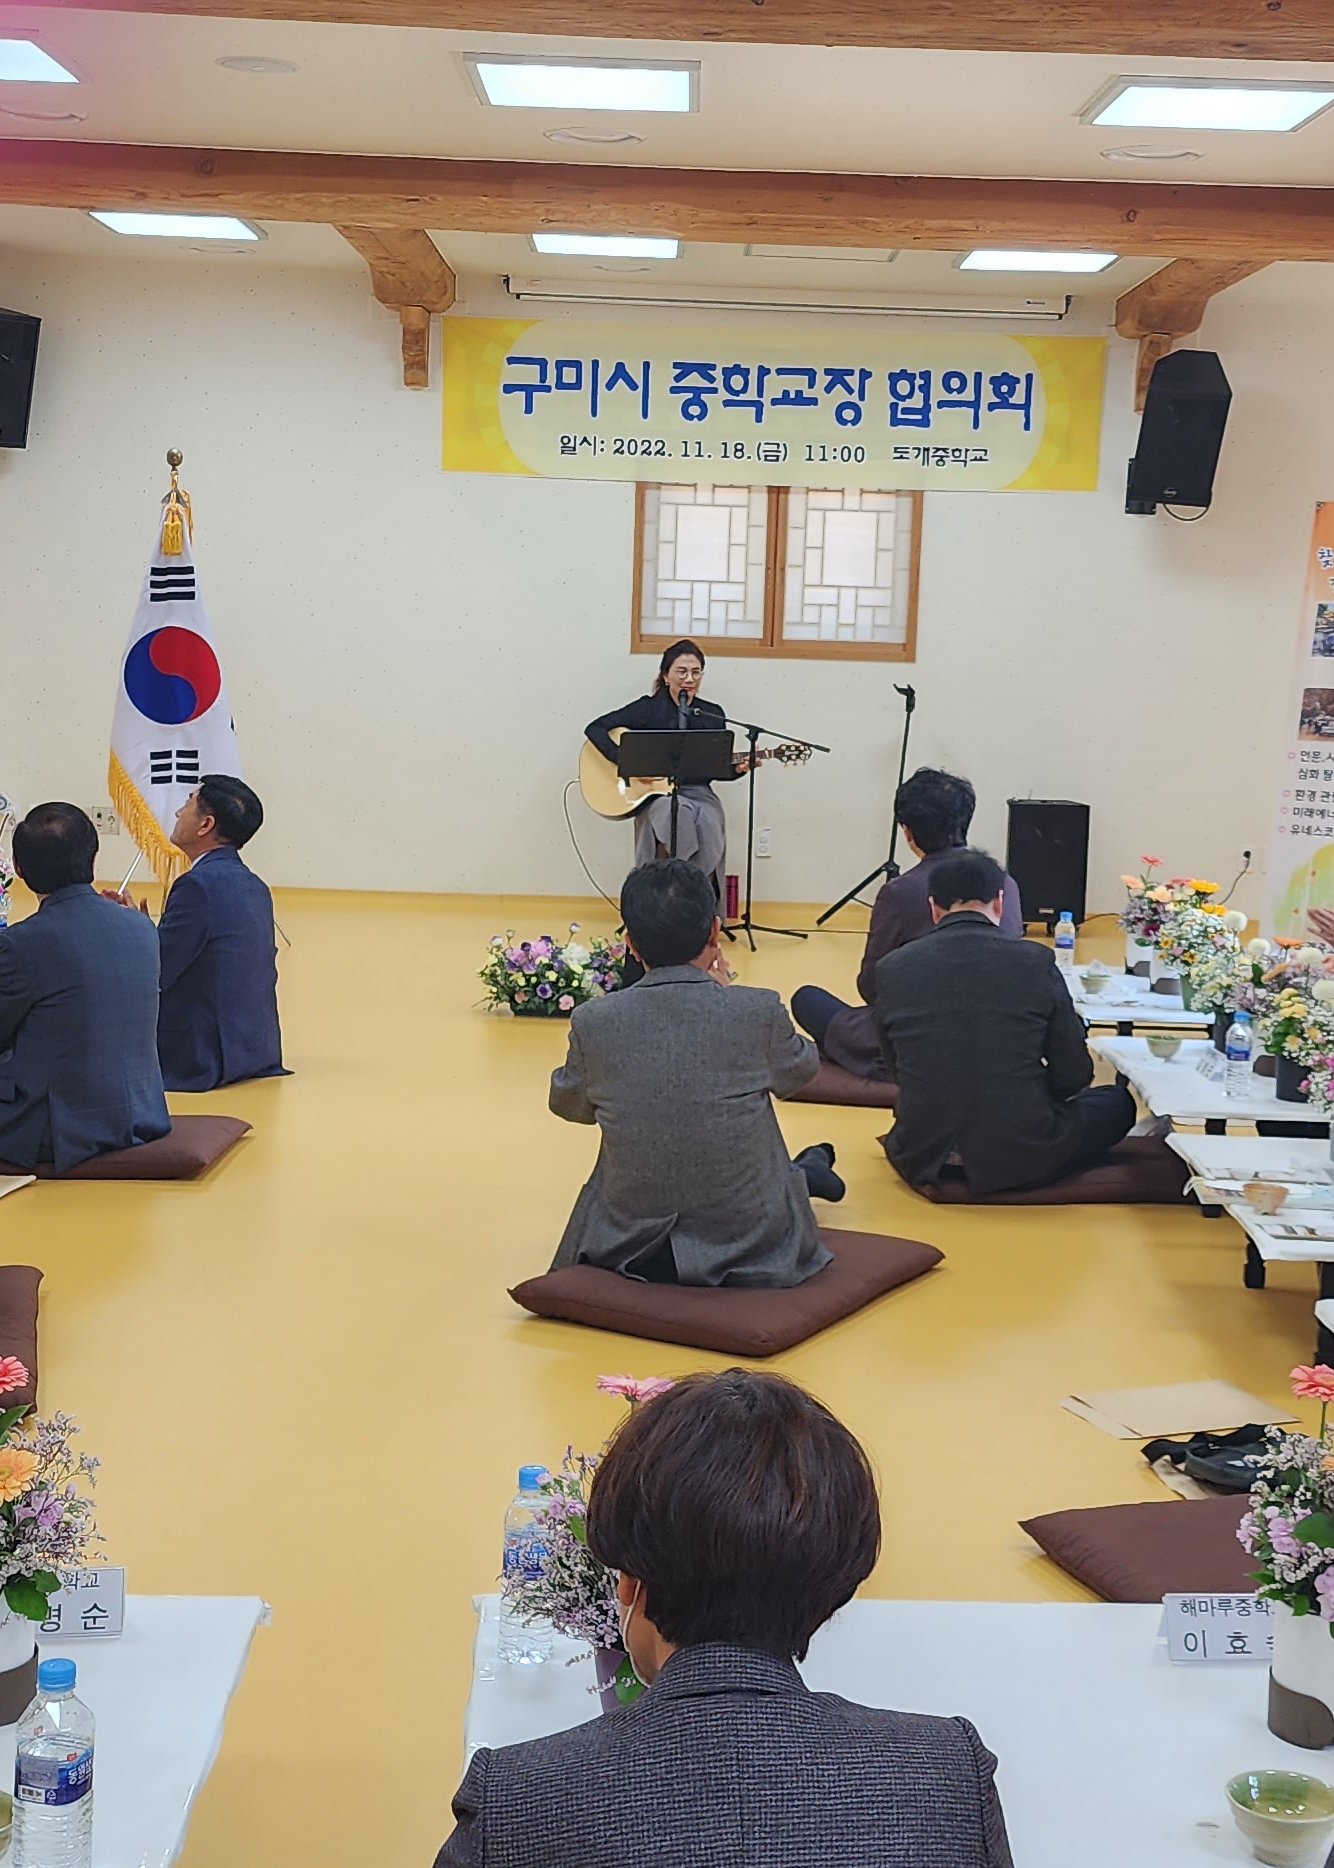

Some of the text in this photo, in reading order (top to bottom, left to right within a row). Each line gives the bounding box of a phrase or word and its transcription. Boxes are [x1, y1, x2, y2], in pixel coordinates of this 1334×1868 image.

[502, 355, 1034, 431] 구미시 중학교장 협의회
[559, 434, 606, 457] 일시:
[612, 438, 673, 458] 2022.
[680, 440, 713, 459] 11.
[804, 444, 866, 463] 11:00
[892, 445, 989, 468] 도개중학교
[1290, 824, 1334, 837] 유네스코
[1179, 1598, 1275, 1617] 해마루중학
